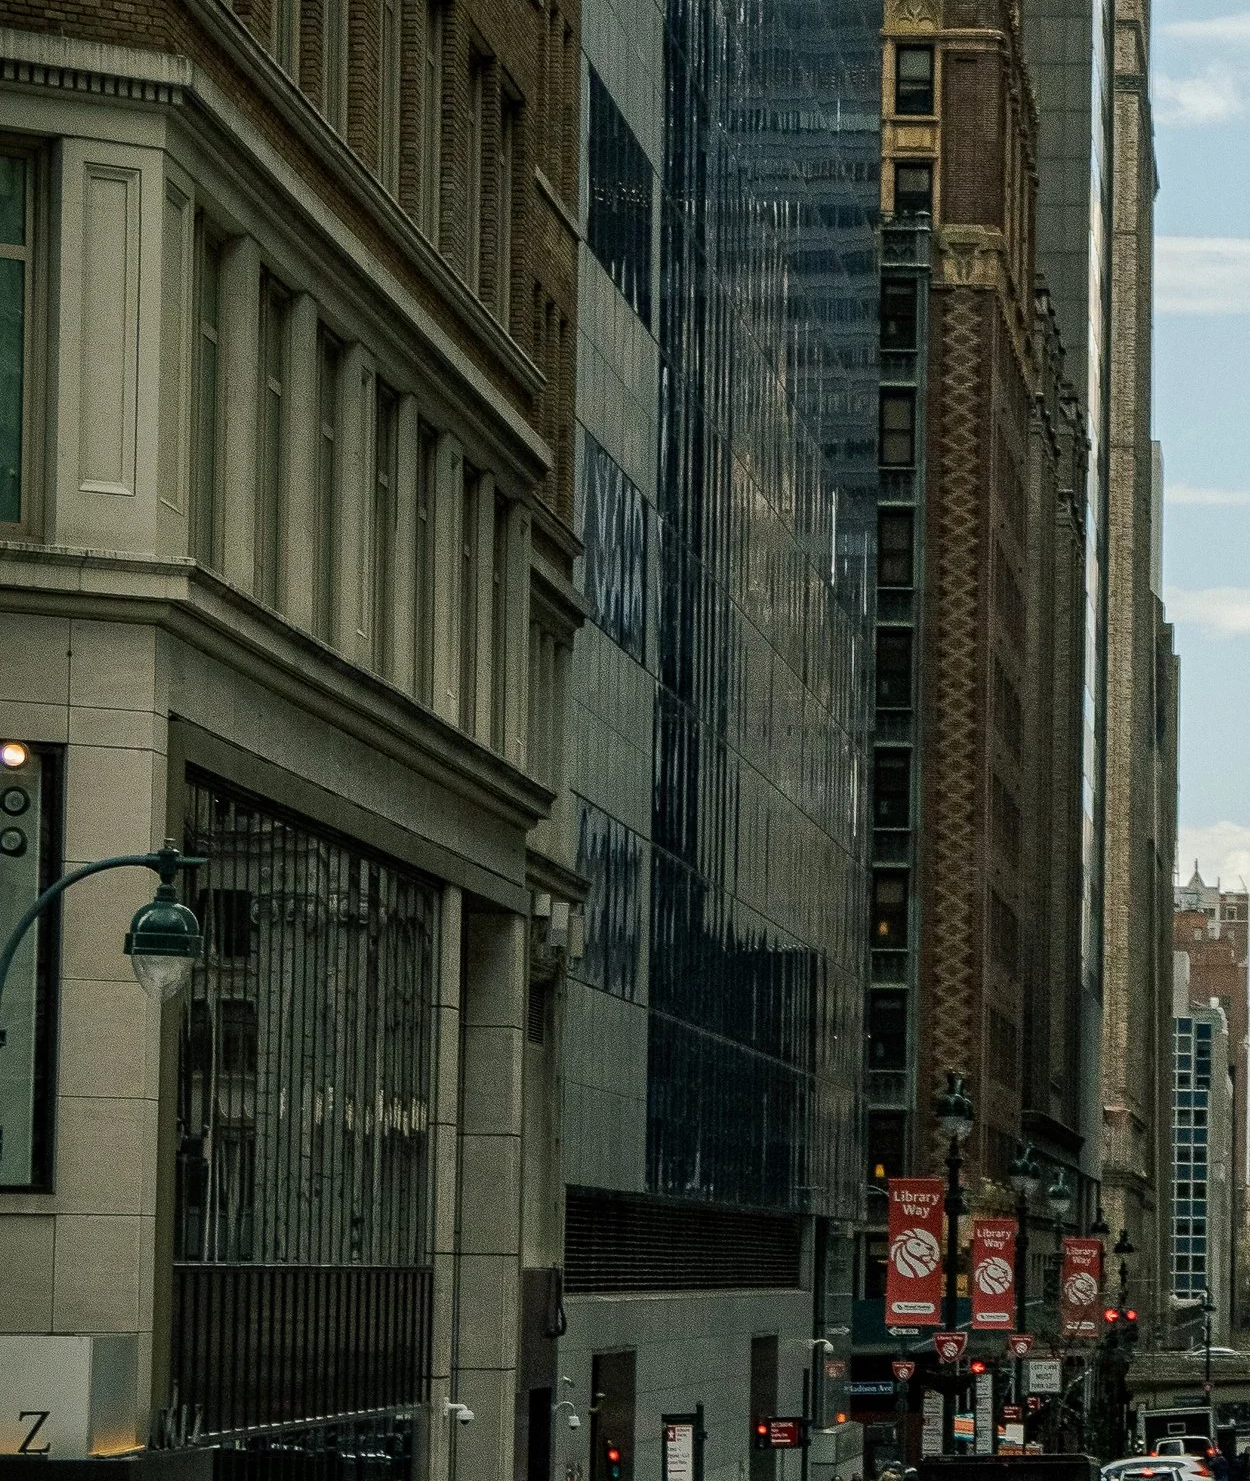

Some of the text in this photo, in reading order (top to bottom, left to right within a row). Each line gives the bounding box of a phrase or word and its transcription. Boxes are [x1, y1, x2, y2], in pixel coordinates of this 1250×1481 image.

[893, 1191, 940, 1205] Library
[902, 1203, 930, 1218] Way
[977, 1228, 1011, 1240] Library
[983, 1238, 1006, 1250] Way
[1066, 1246, 1098, 1257] Library
[1072, 1256, 1092, 1266] Way
[18, 1411, 51, 1453] Z
